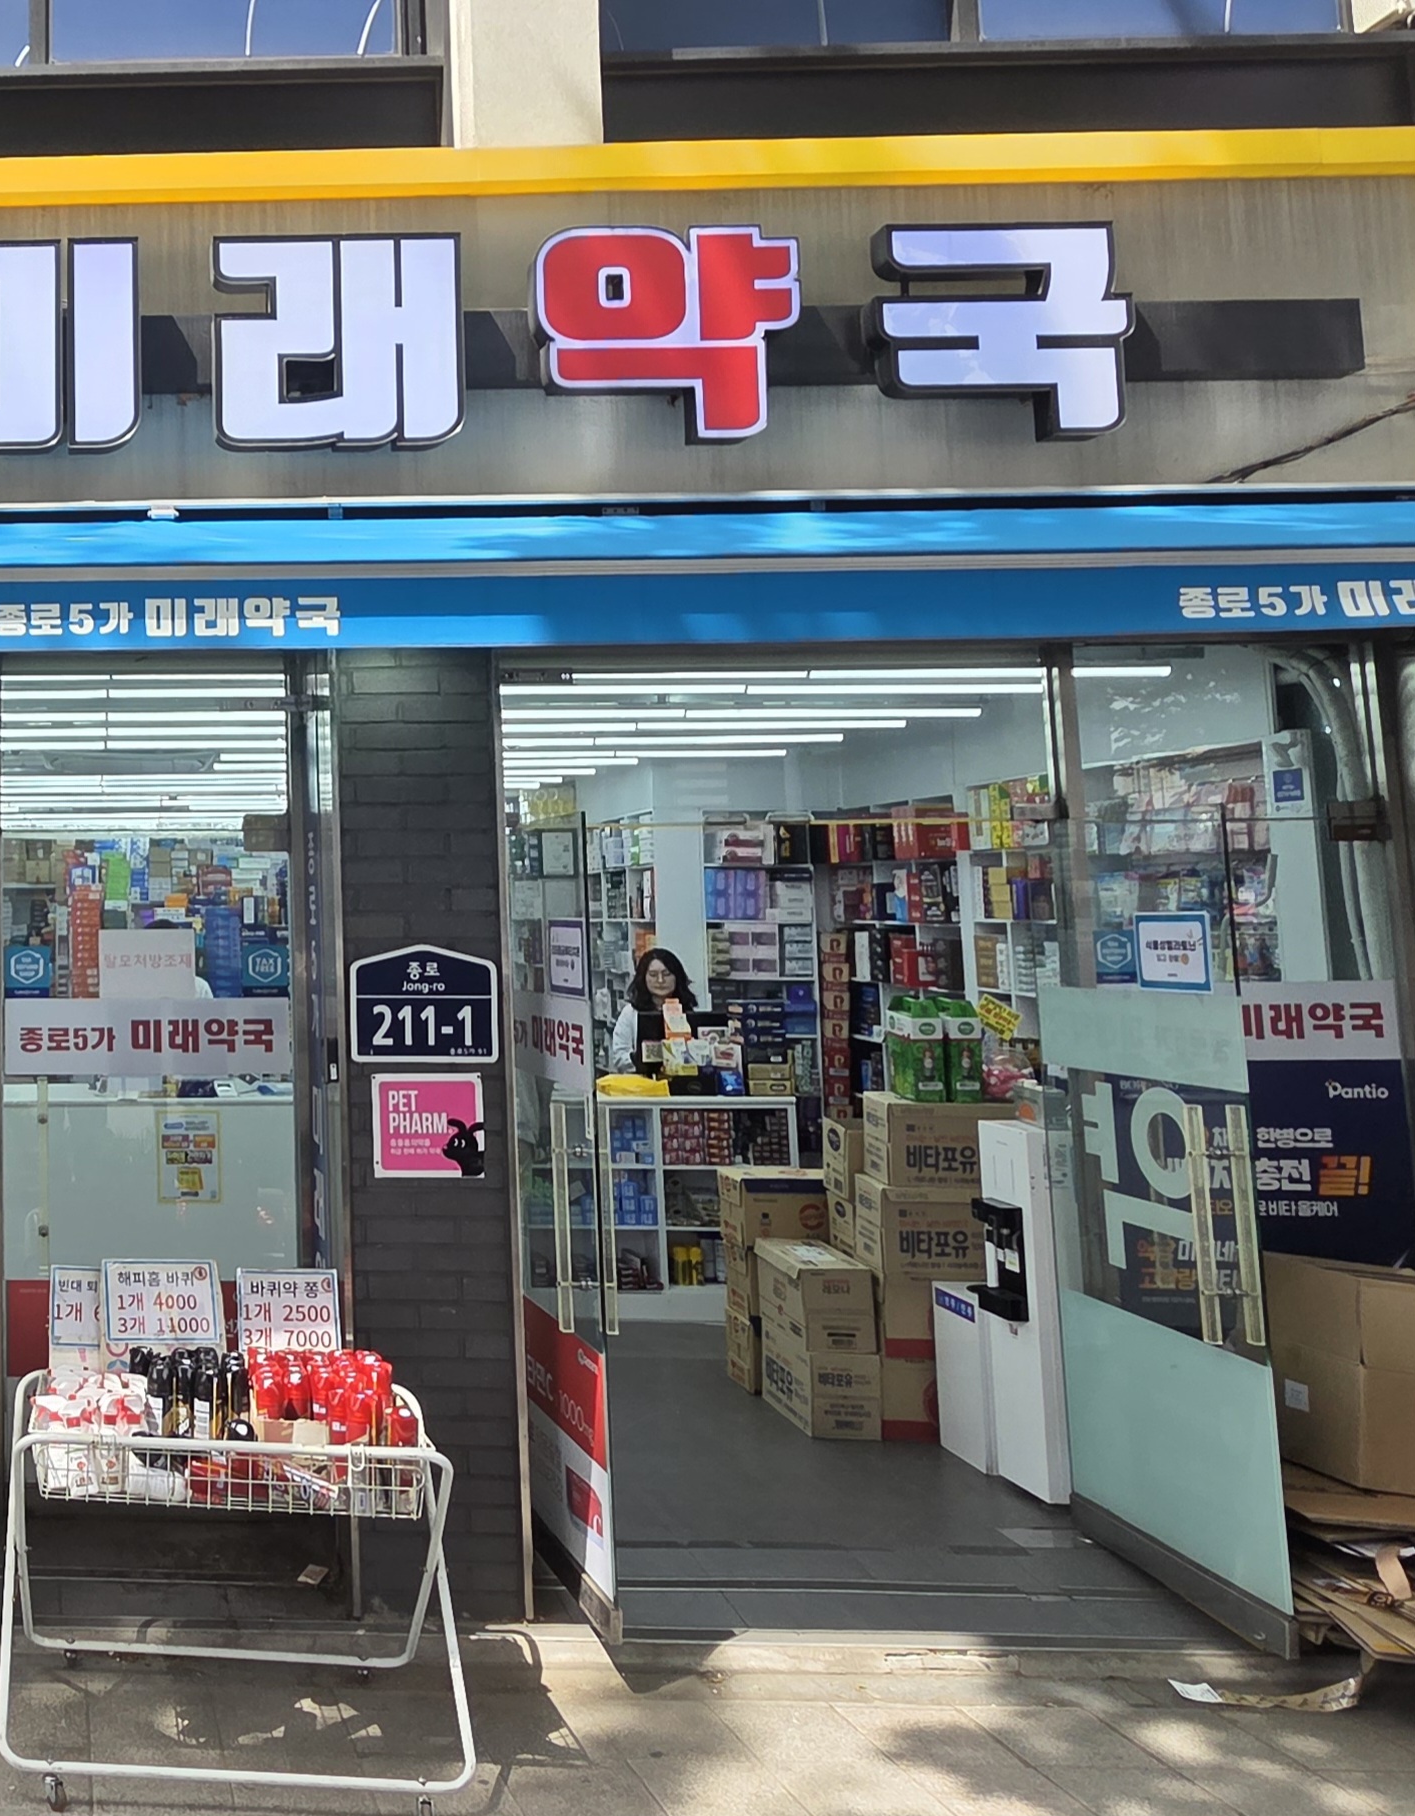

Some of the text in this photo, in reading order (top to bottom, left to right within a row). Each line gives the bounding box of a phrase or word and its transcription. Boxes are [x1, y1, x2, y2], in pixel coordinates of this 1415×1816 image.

[1178, 585, 1328, 619] 종로5가
[144, 596, 342, 638] 미래약국
[255, 956, 276, 966] TAX
[406, 962, 440, 981] 종로
[402, 981, 446, 994] Jong-ro
[19, 1018, 275, 1053] 종로5가 미래약국
[372, 1004, 473, 1047] 211-1
[531, 1014, 585, 1066] 미래약국
[1325, 1079, 1389, 1099] Pantio
[388, 1090, 419, 1112] PET
[1256, 1127, 1334, 1149] 한병으로
[905, 1144, 978, 1174] 비타포유
[1254, 1157, 1312, 1192] 충전
[898, 1229, 970, 1260] 비타포유
[58, 1280, 83, 1294] 빈대
[117, 1270, 195, 1288] 해피홈 바퀴
[250, 1280, 299, 1299] 바퀴약
[53, 1302, 83, 1323] 1개
[117, 1291, 198, 1312] 1개 4000
[243, 1301, 331, 1323] 1개 2500
[117, 1315, 210, 1335] 3개 11000
[243, 1326, 332, 1348] 3개 7000
